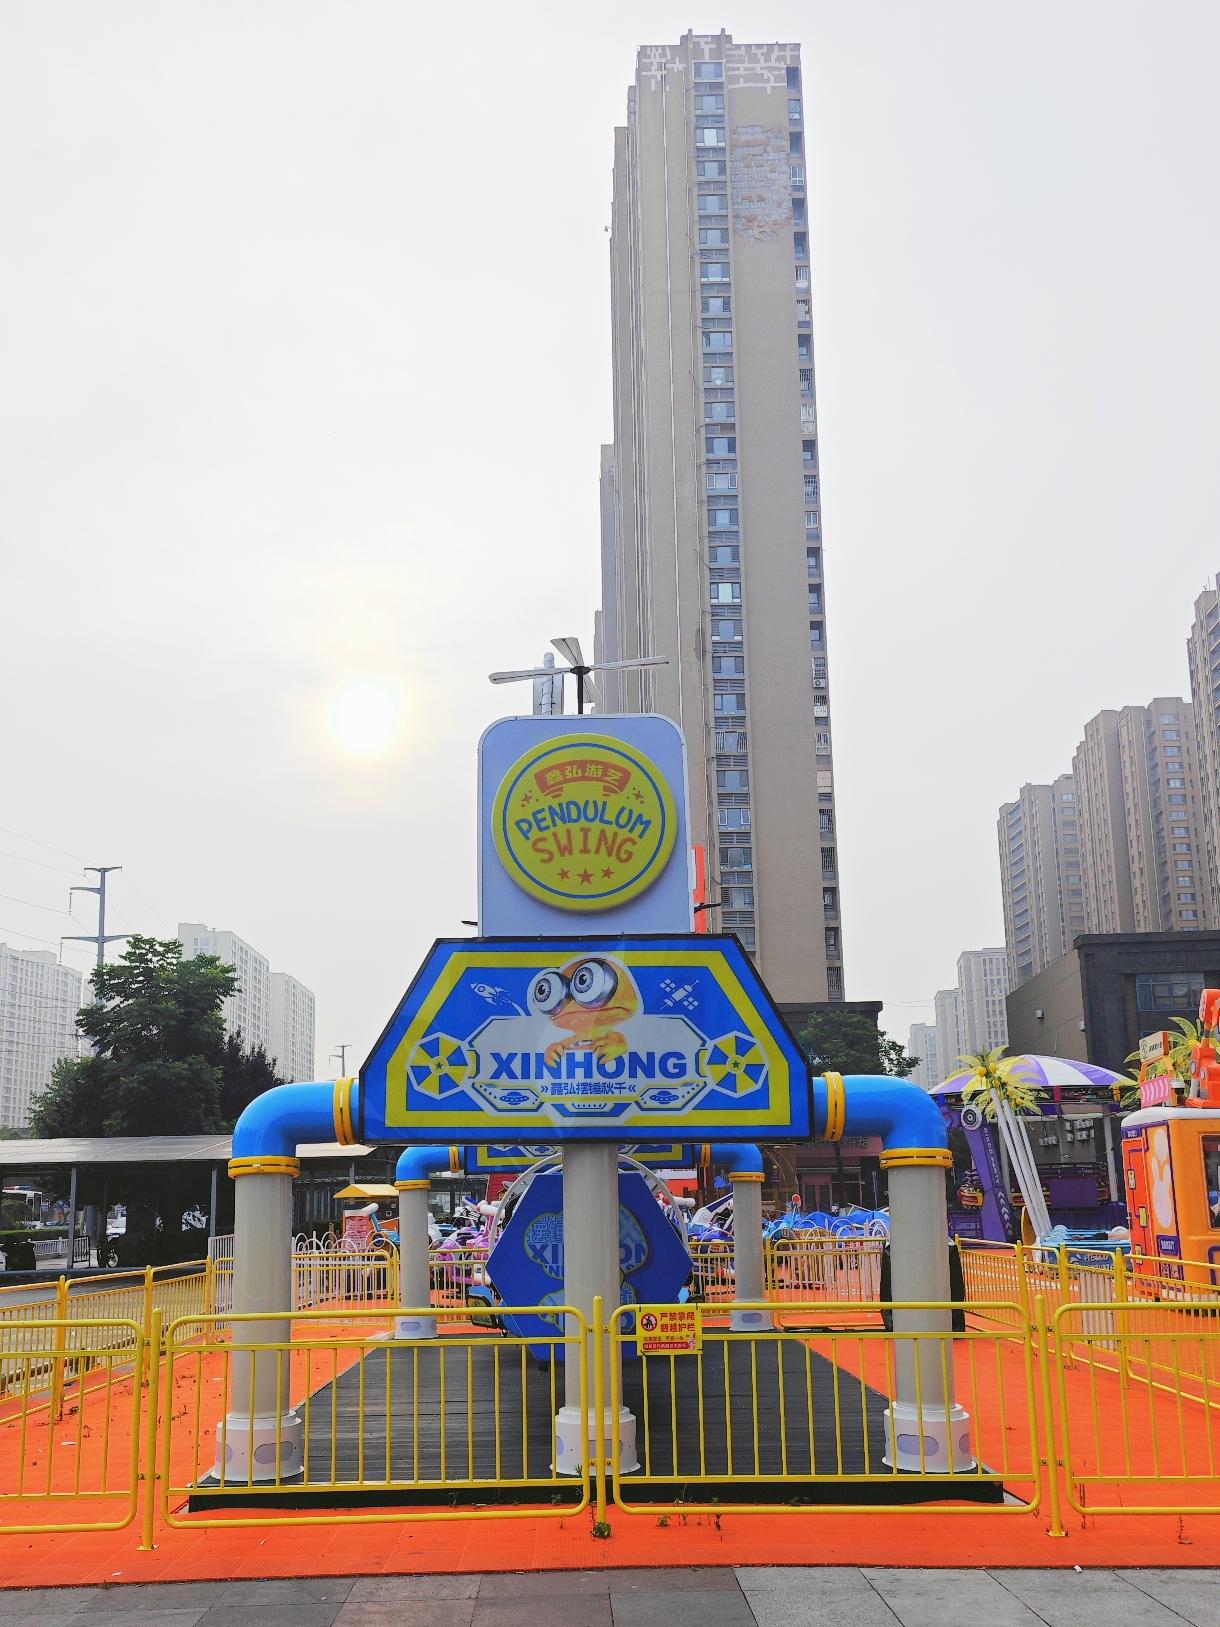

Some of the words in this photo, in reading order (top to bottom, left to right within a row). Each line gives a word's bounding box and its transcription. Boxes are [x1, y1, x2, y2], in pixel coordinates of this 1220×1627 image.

[514, 799, 652, 841] PENDULUM
[531, 827, 637, 864] SWING
[489, 1051, 687, 1080] XINHONG
